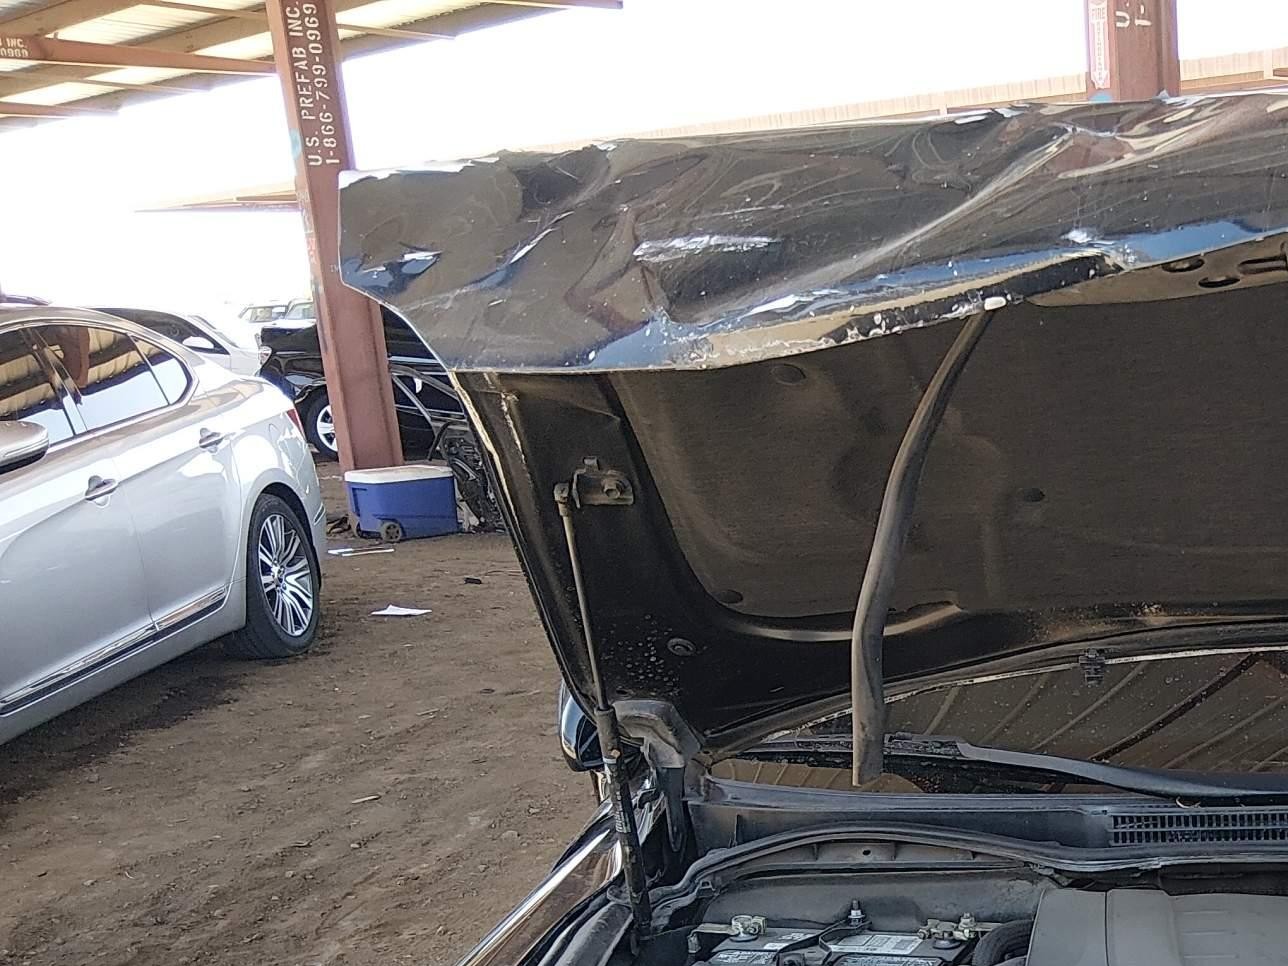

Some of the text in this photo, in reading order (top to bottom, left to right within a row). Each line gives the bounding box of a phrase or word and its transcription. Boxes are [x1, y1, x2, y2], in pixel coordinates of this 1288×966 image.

[285, 1, 323, 166] U.S. PREFAB INC.
[302, 3, 340, 165] 1-866-799-0969
